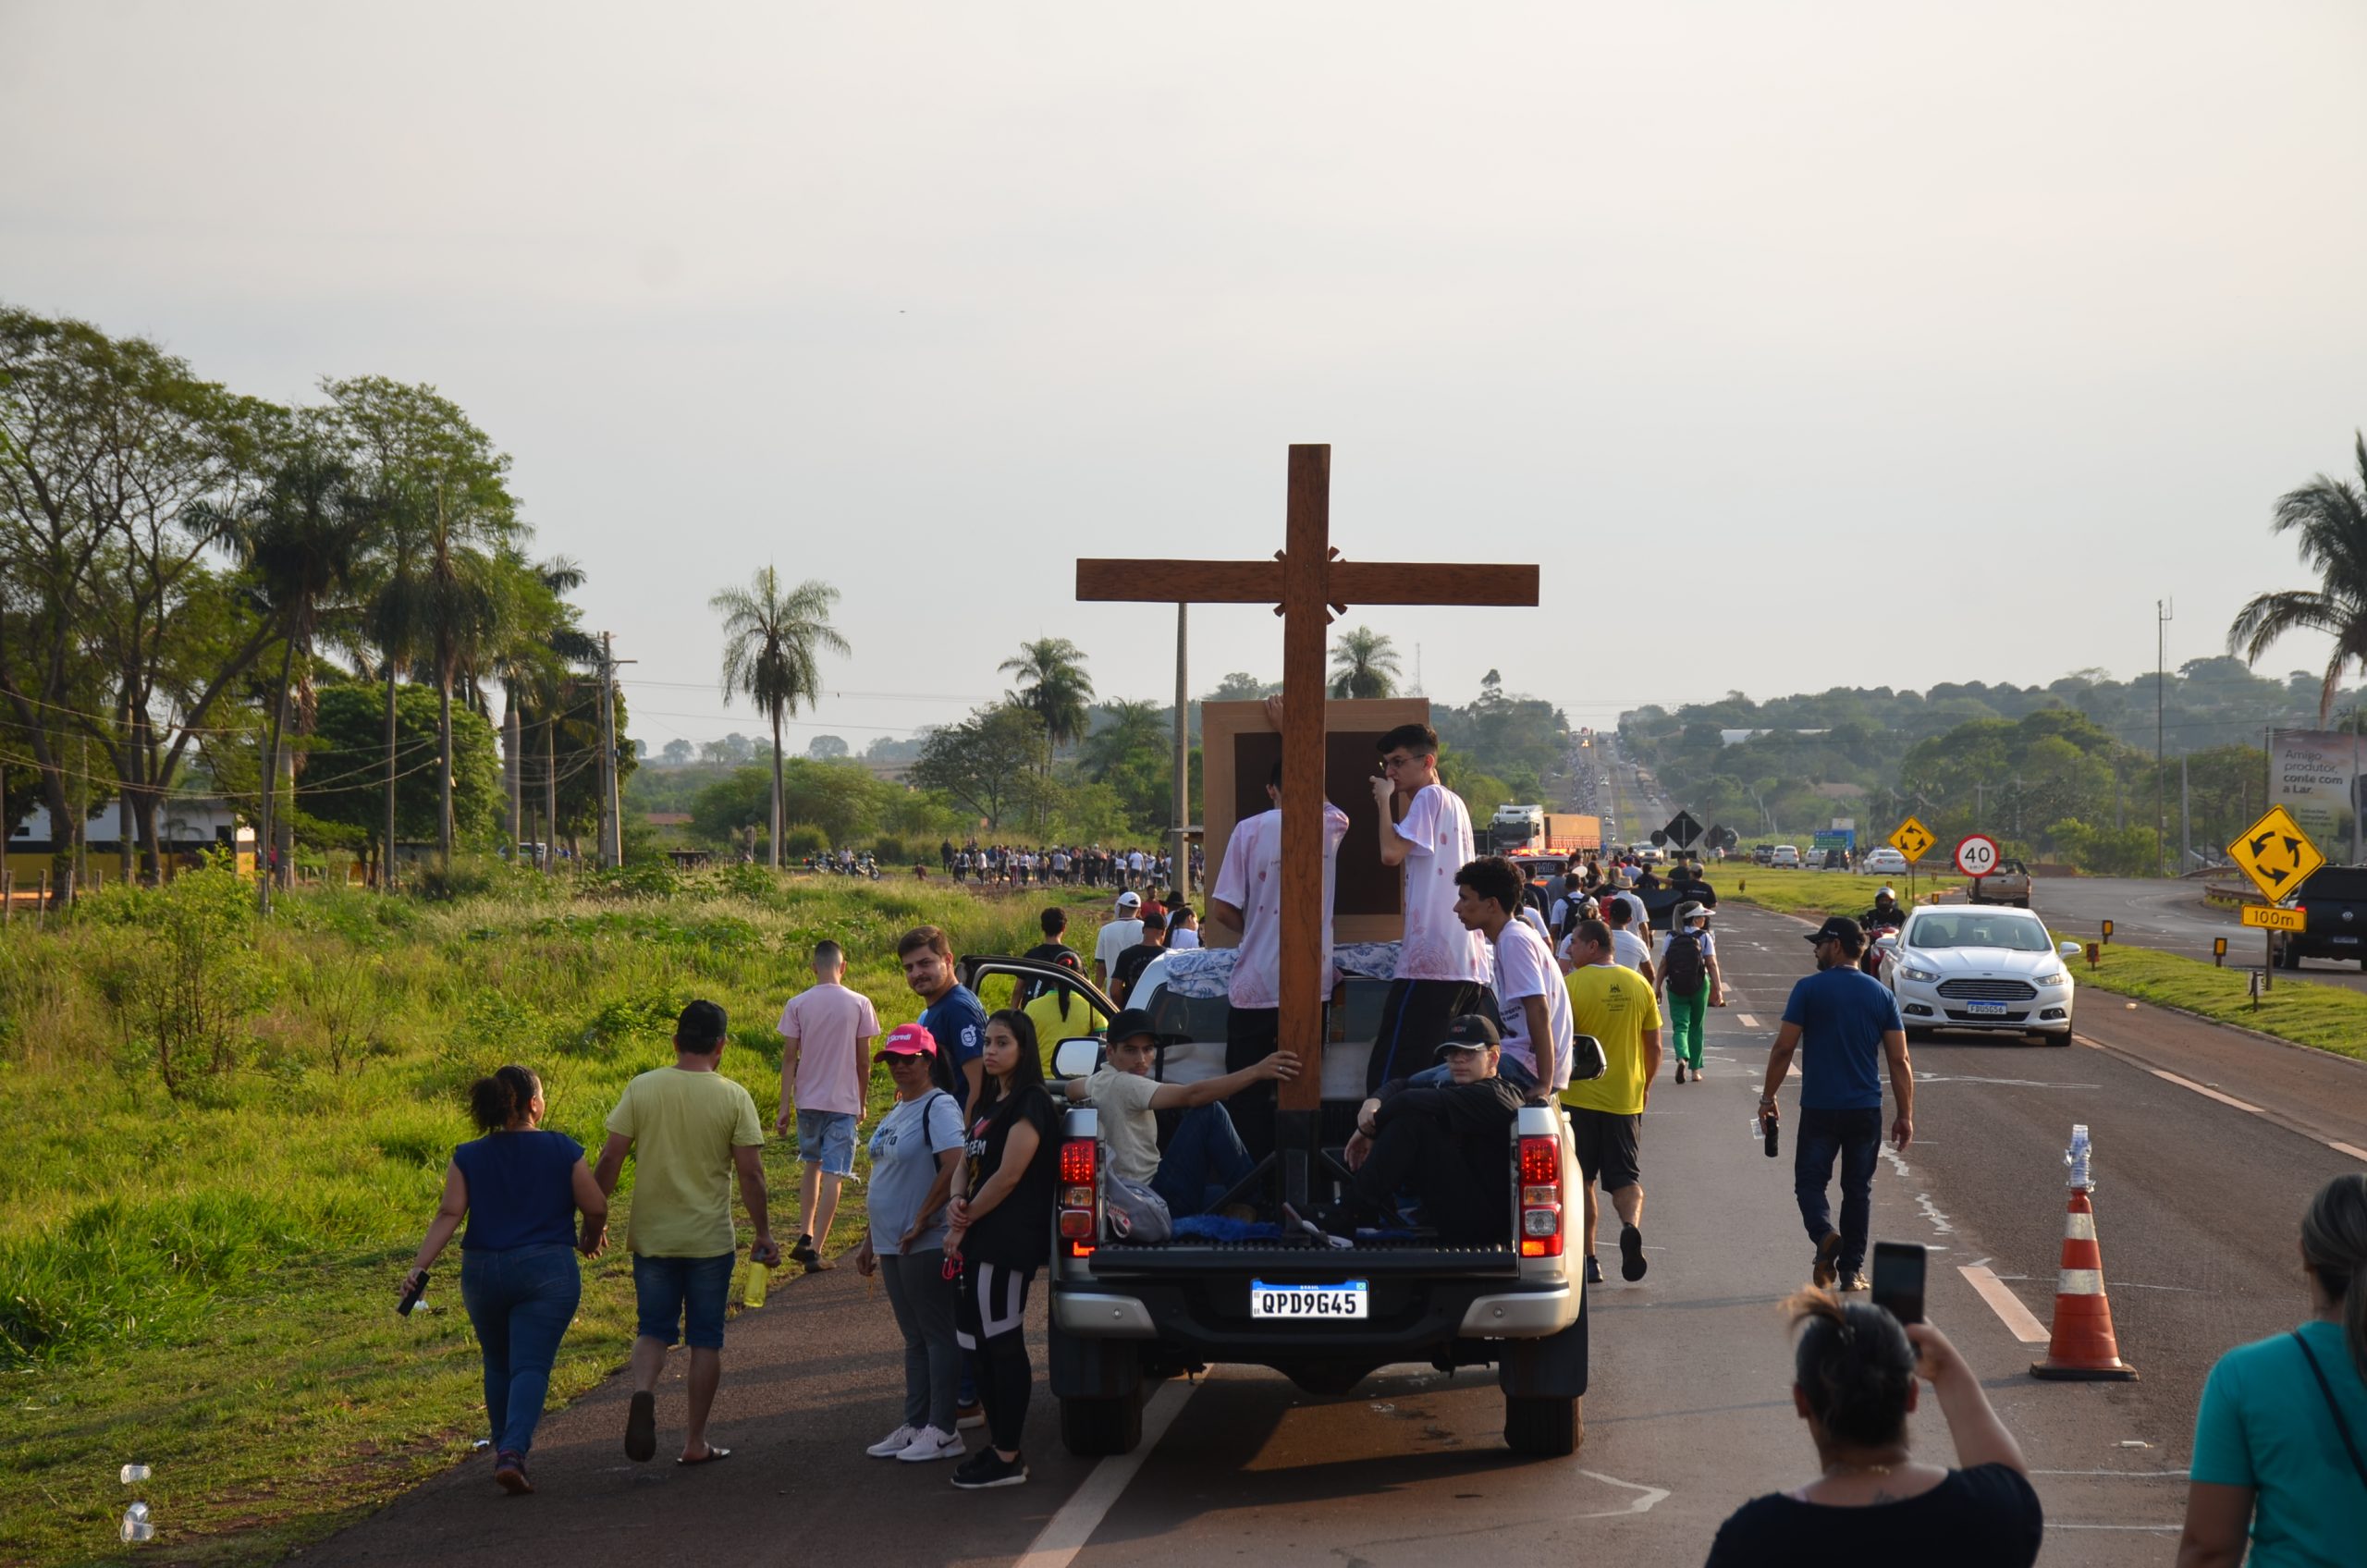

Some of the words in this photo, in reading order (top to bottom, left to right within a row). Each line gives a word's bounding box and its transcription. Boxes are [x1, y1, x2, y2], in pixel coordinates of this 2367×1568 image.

[2285, 749, 2323, 762] Amigo
[2284, 762, 2337, 775] produtor,
[2283, 774, 2316, 784] conte
[2318, 776, 2343, 785] com
[2283, 785, 2290, 793] a
[1965, 846, 1991, 864] 40
[2254, 910, 2294, 926] 100m
[1262, 1292, 1357, 1315] QPD9G45
